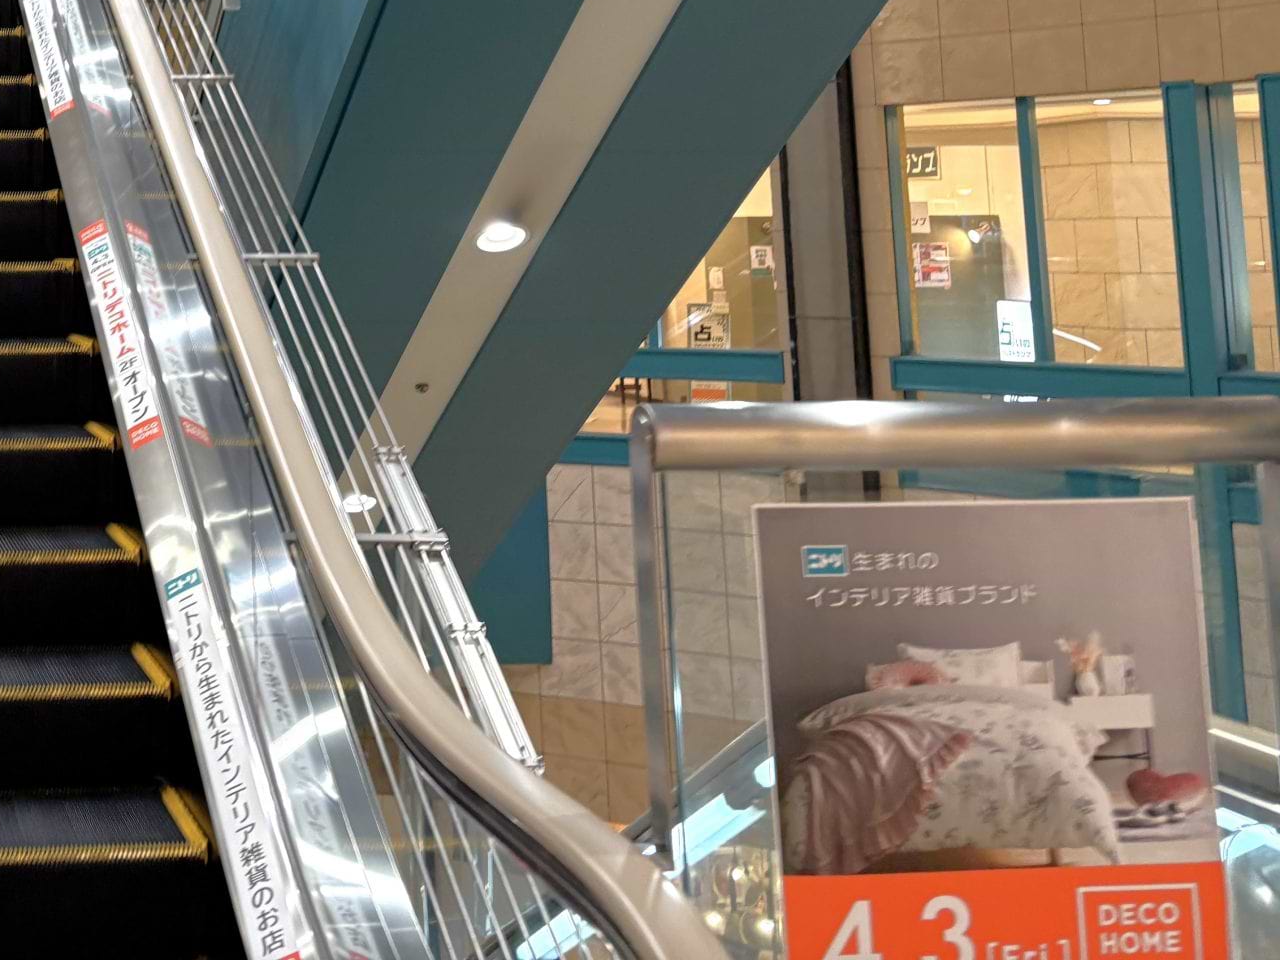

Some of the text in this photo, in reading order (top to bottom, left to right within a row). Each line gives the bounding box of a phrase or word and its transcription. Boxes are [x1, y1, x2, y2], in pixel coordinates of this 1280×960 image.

[96, 270, 149, 423] ニトリデコホーム 2F オープン
[851, 551, 940, 572] 生まれの
[805, 584, 1038, 609] インテリア雑貨ブランド
[177, 594, 286, 958] ニトリから生まれたインテリア雑貨のお店
[1098, 902, 1181, 926] DECO
[1100, 930, 1183, 954] HOME
